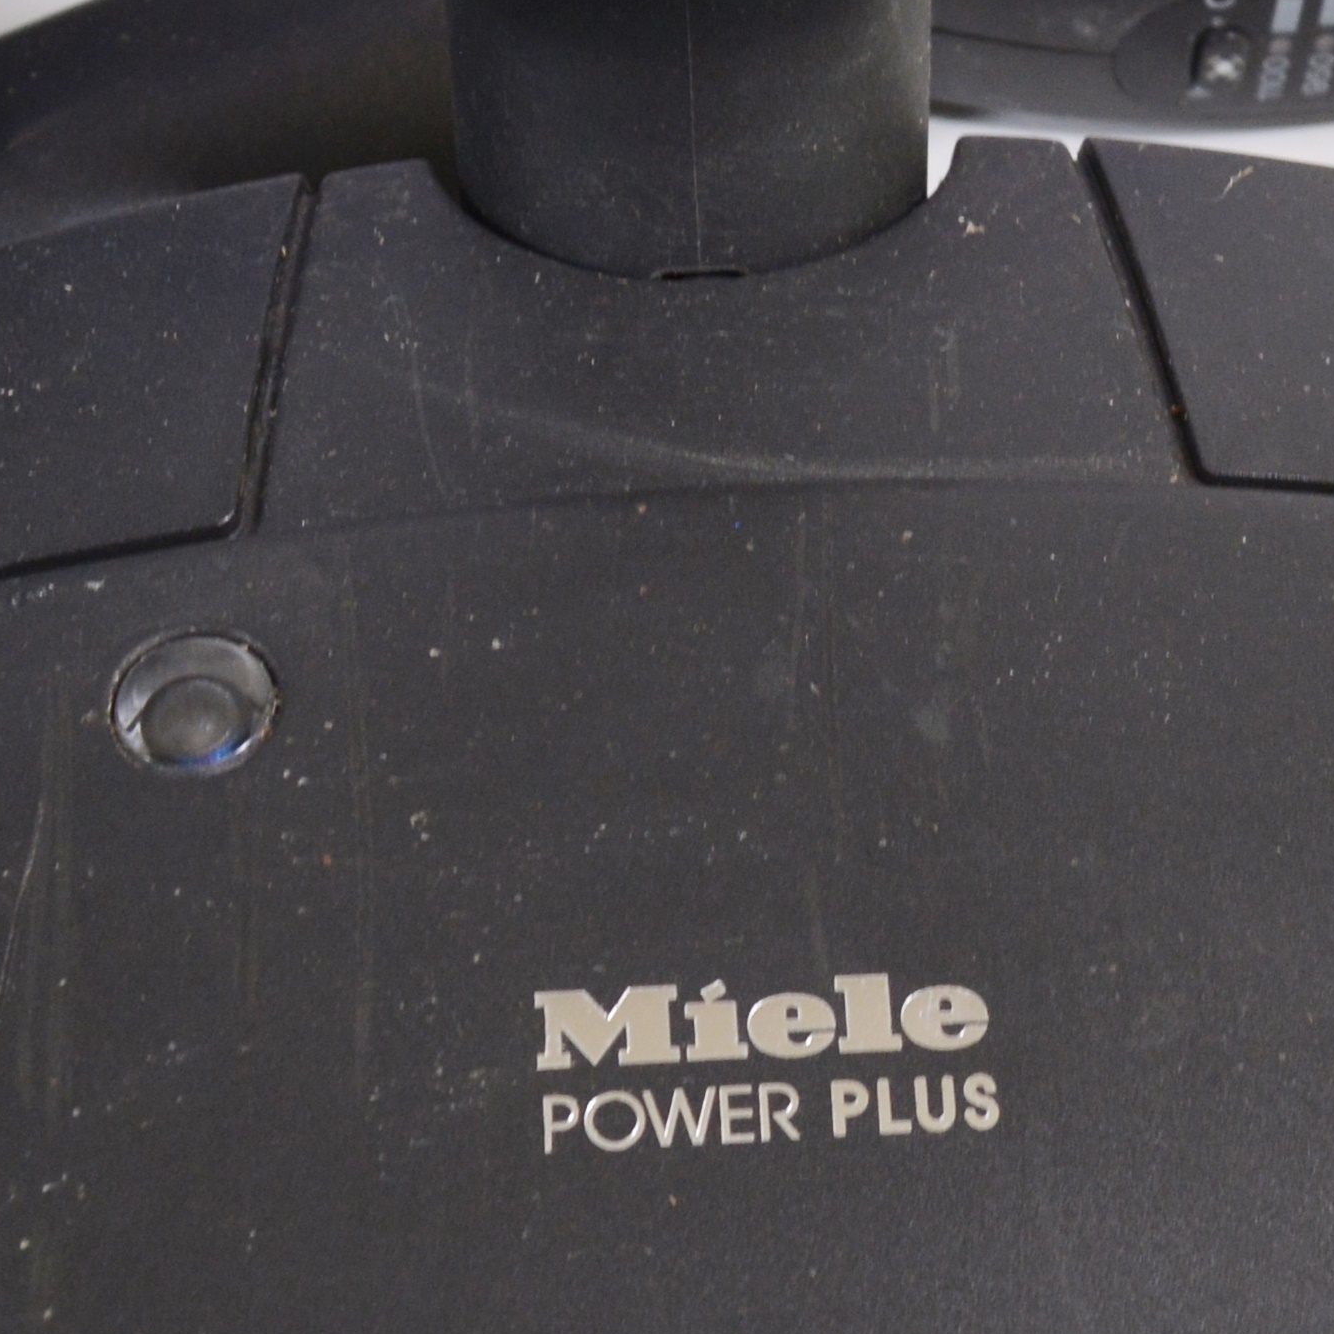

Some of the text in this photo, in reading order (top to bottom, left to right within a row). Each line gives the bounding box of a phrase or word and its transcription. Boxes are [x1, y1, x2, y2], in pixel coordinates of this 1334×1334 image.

[533, 973, 989, 1071] Miele
[542, 1072, 1001, 1155] POWER PLUS
